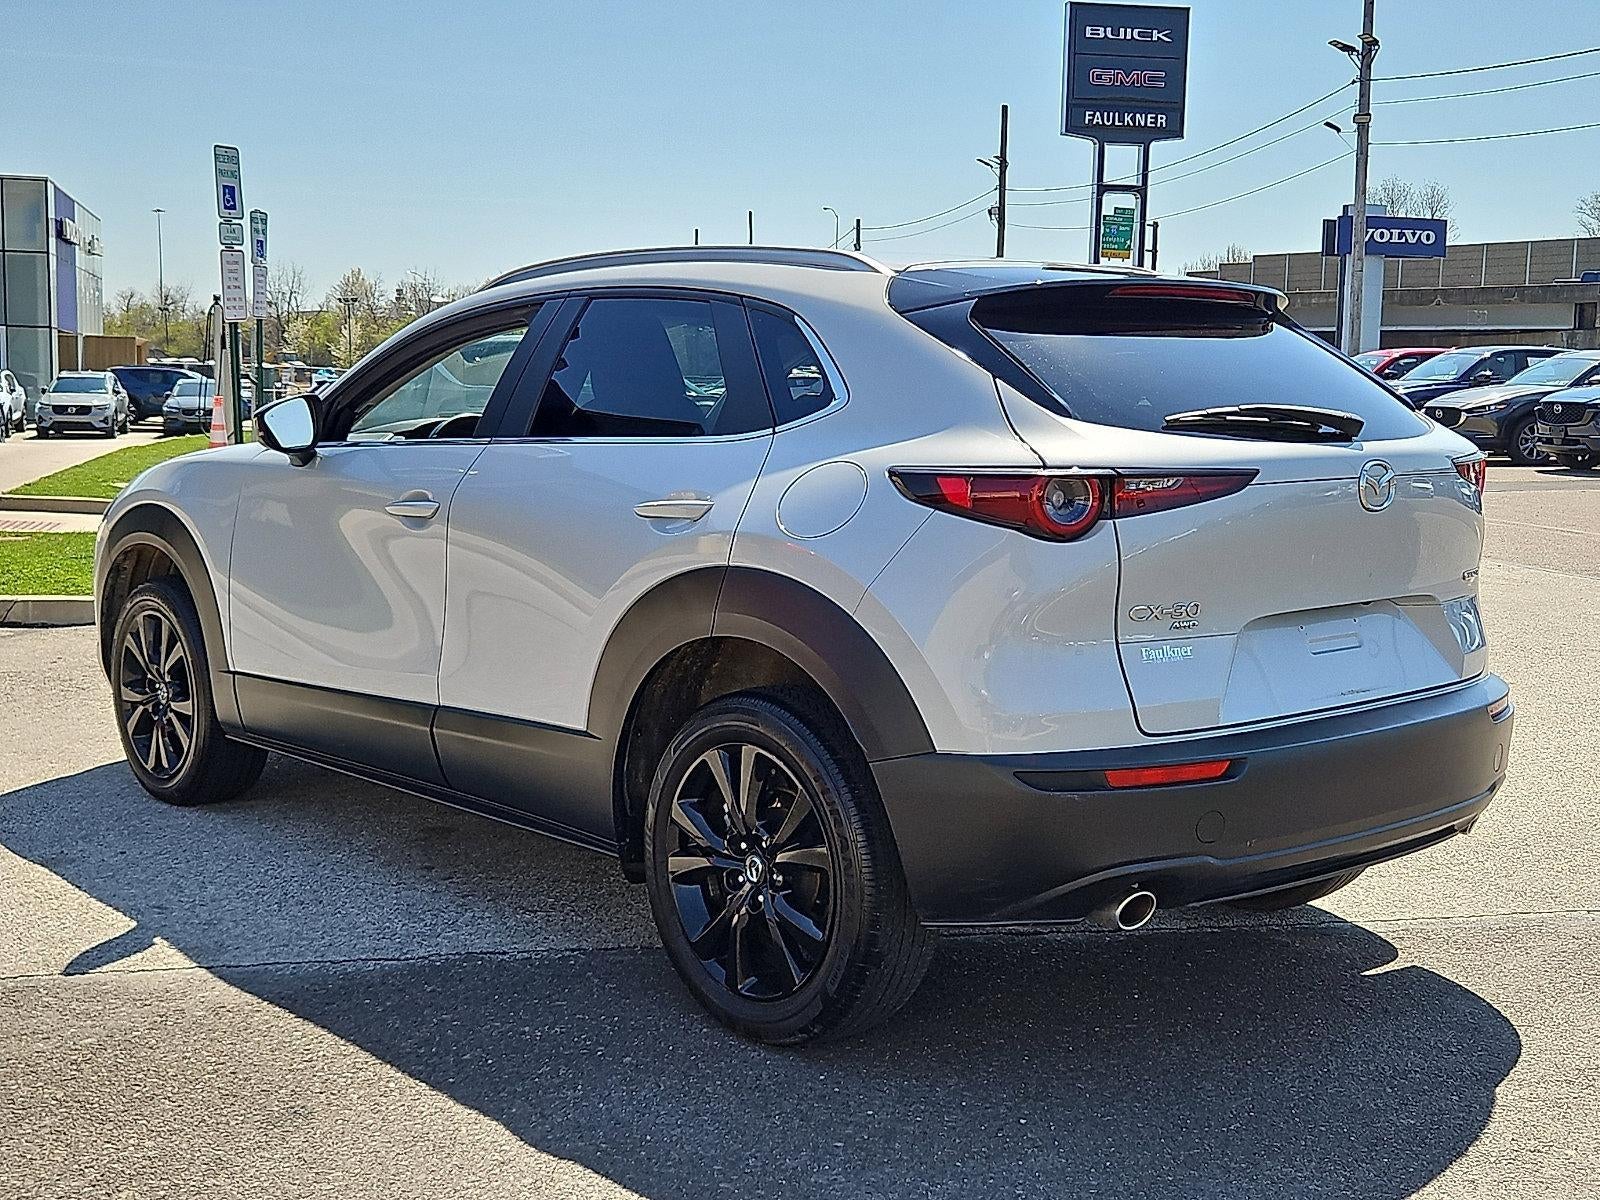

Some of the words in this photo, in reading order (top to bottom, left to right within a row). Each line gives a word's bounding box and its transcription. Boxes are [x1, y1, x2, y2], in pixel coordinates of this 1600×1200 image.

[1085, 26, 1173, 42] BUICK
[1089, 68, 1166, 88] GMC
[1084, 111, 1167, 128] FAULKNER
[1129, 601, 1201, 622] CX-30
[1169, 620, 1199, 631] AWD
[1140, 645, 1193, 661] Faulkner
